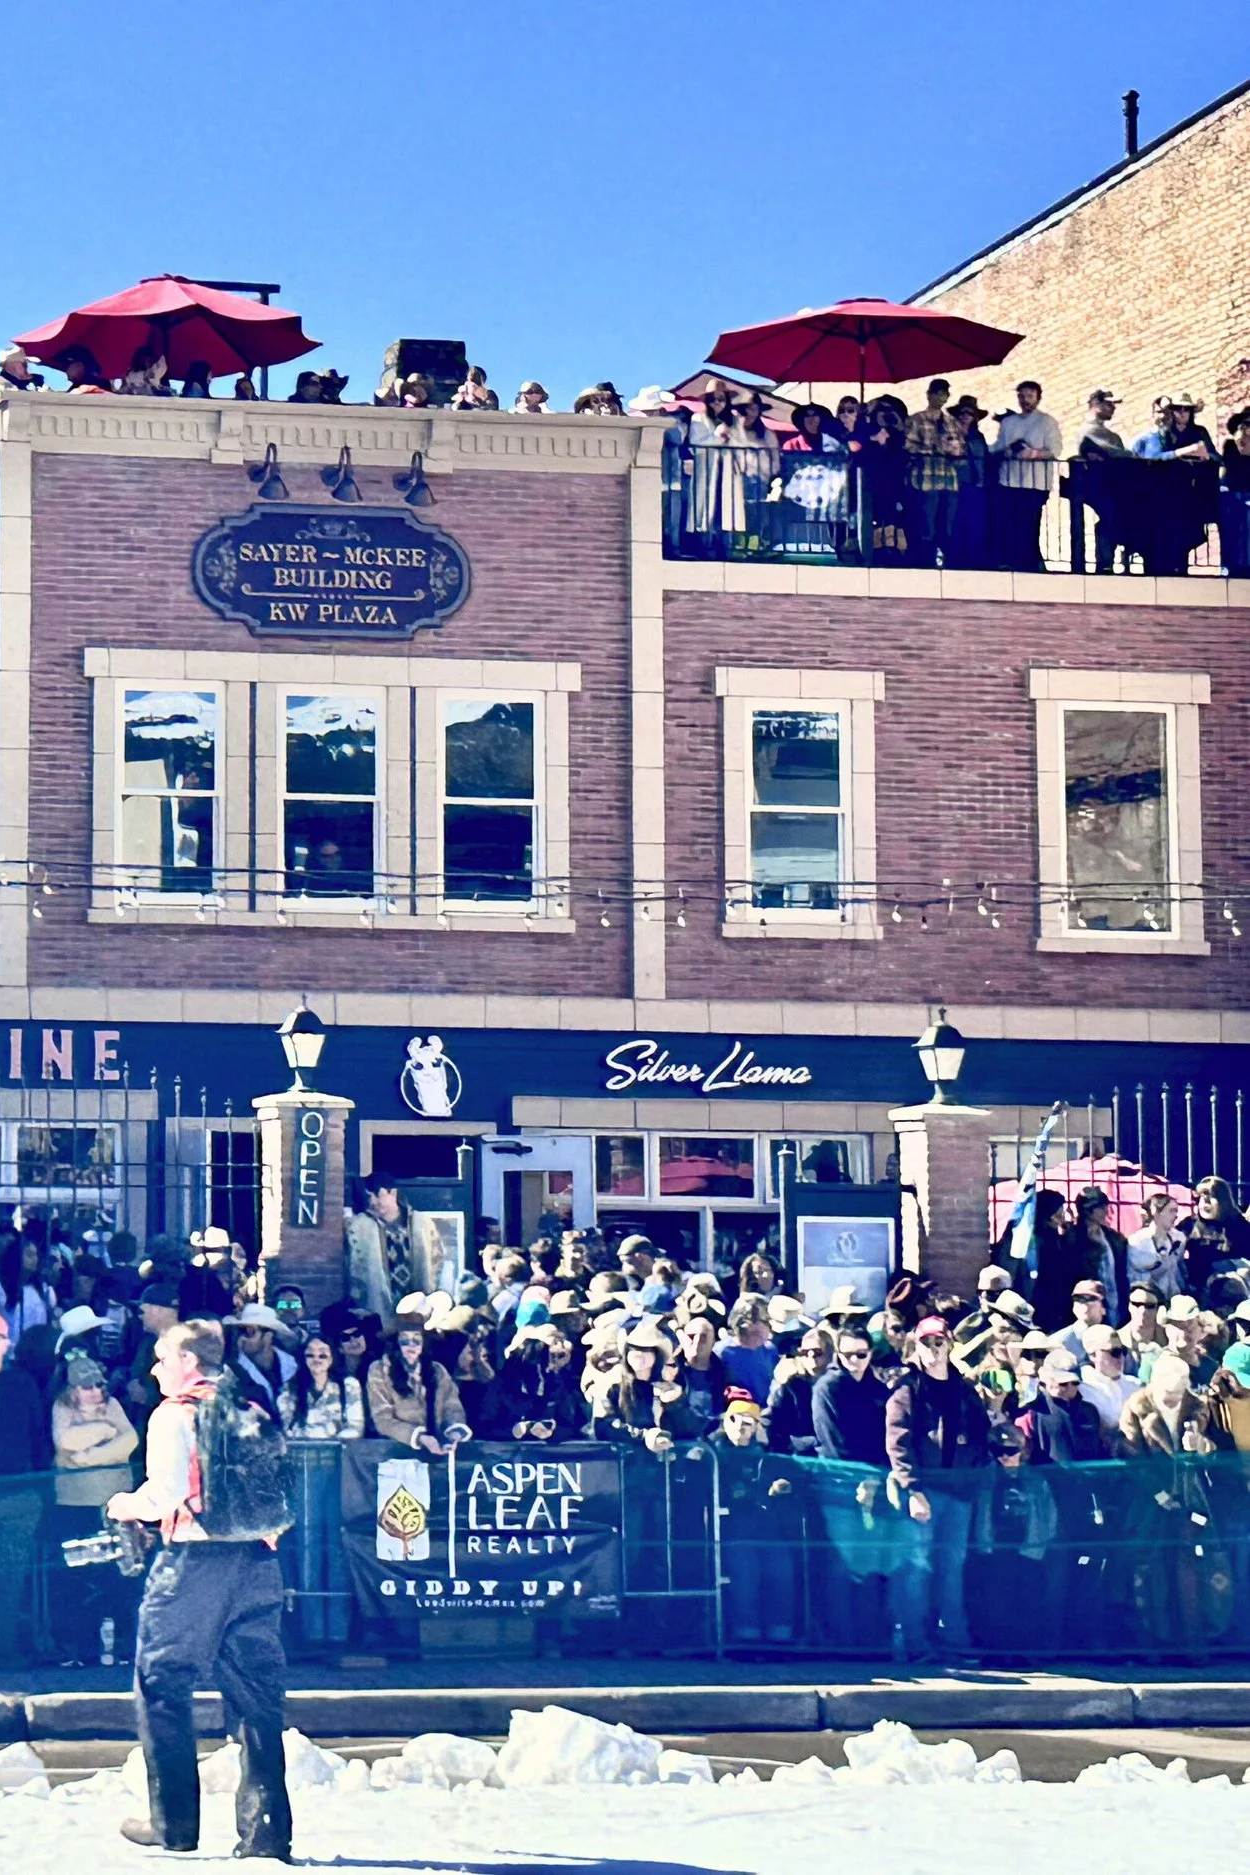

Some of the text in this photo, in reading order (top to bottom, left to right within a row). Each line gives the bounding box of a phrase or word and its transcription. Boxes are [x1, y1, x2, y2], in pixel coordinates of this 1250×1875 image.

[239, 543, 318, 564] SAYER
[274, 568, 392, 590] BUILDING
[269, 602, 398, 626] KW PLAZA
[605, 1039, 813, 1093] Silver Llama
[297, 1111, 325, 1225] OPEN
[467, 1463, 582, 1495] ASPEN
[467, 1496, 584, 1531] LEAF
[467, 1536, 577, 1554] REALTY
[380, 1580, 583, 1596] GIDDY UP!
